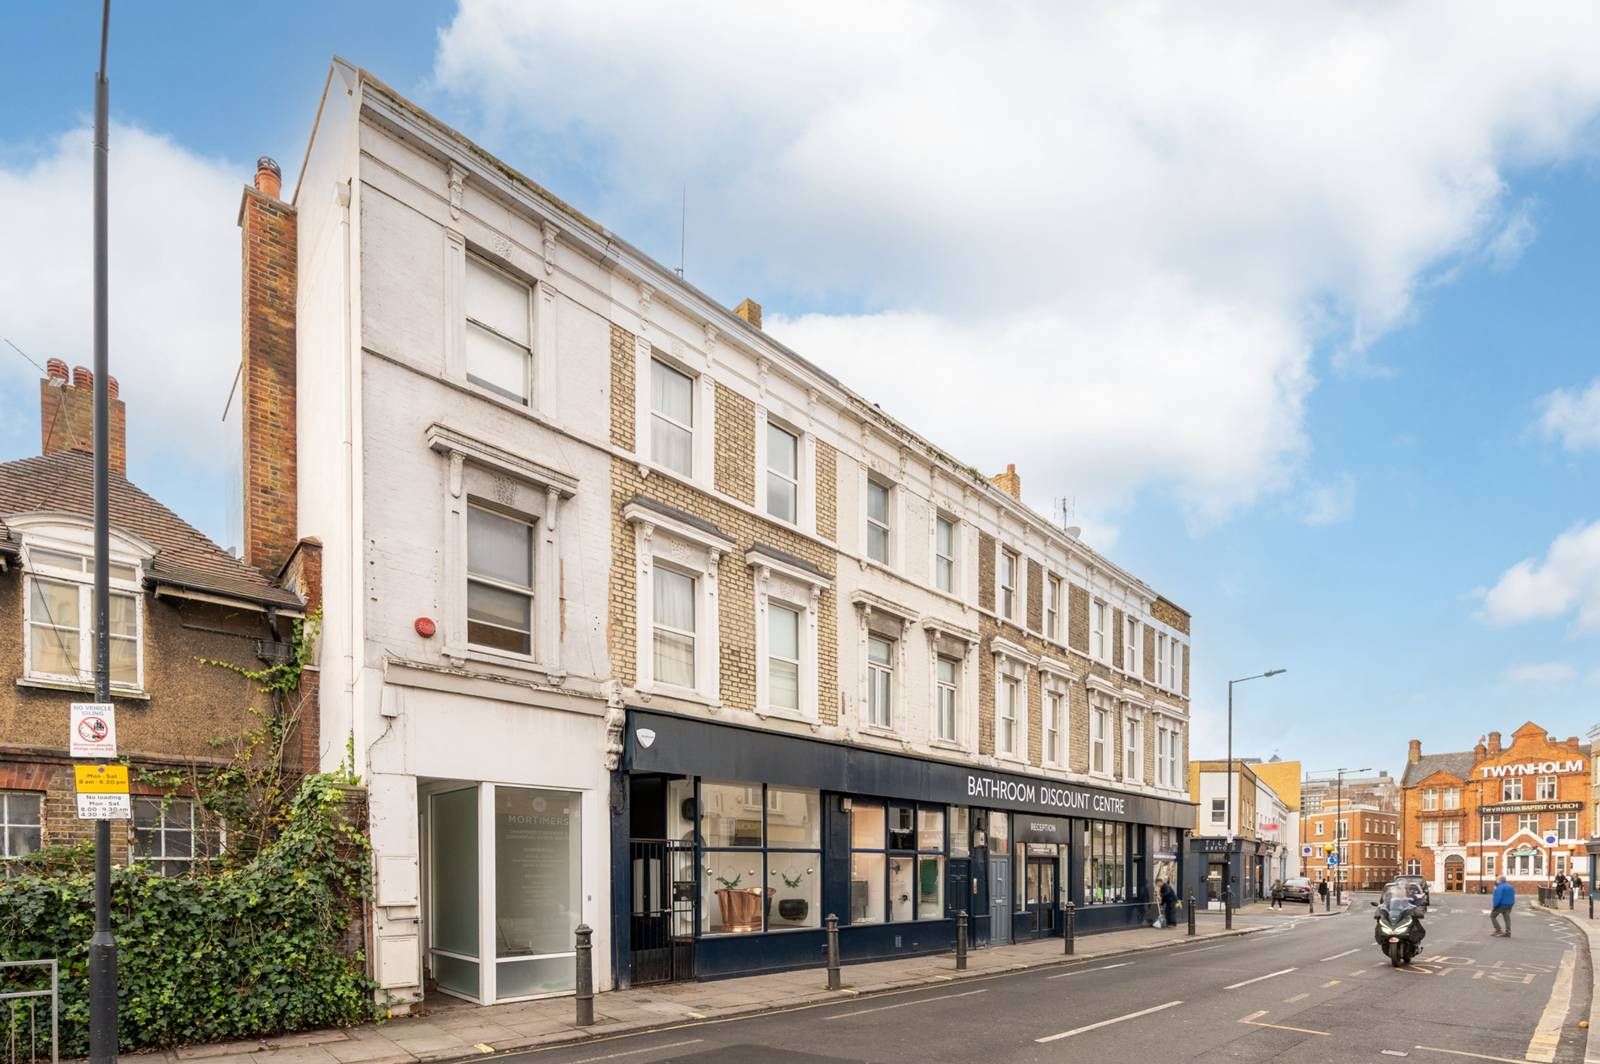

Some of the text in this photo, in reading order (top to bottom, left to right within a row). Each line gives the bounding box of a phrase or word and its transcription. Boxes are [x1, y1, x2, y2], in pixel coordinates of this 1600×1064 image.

[1480, 760, 1583, 778] TWYNHOLM
[968, 775, 1125, 814] BATHROOM DISCOUNT CENTRE
[1482, 805, 1521, 813] Twynholm
[508, 815, 569, 826] MORTIMERS
[1030, 822, 1057, 832] RECEPTION
